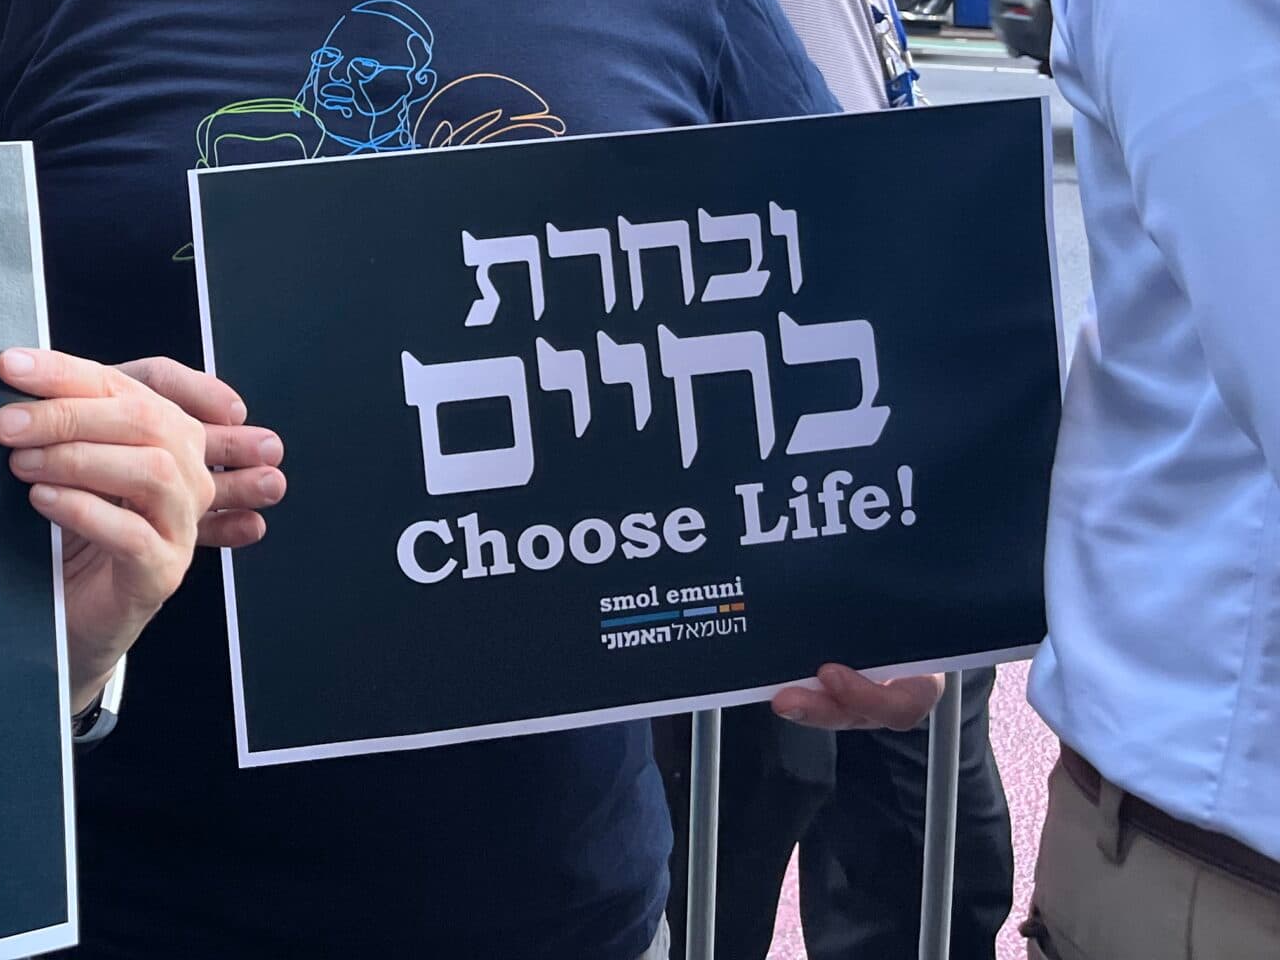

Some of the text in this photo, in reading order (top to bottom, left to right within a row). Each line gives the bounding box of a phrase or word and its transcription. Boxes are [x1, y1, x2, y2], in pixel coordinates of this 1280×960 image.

[461, 201, 803, 327] ובחרת
[400, 311, 891, 496] בחיים
[396, 464, 916, 584] Choose Life!
[600, 576, 744, 612] smol emuni
